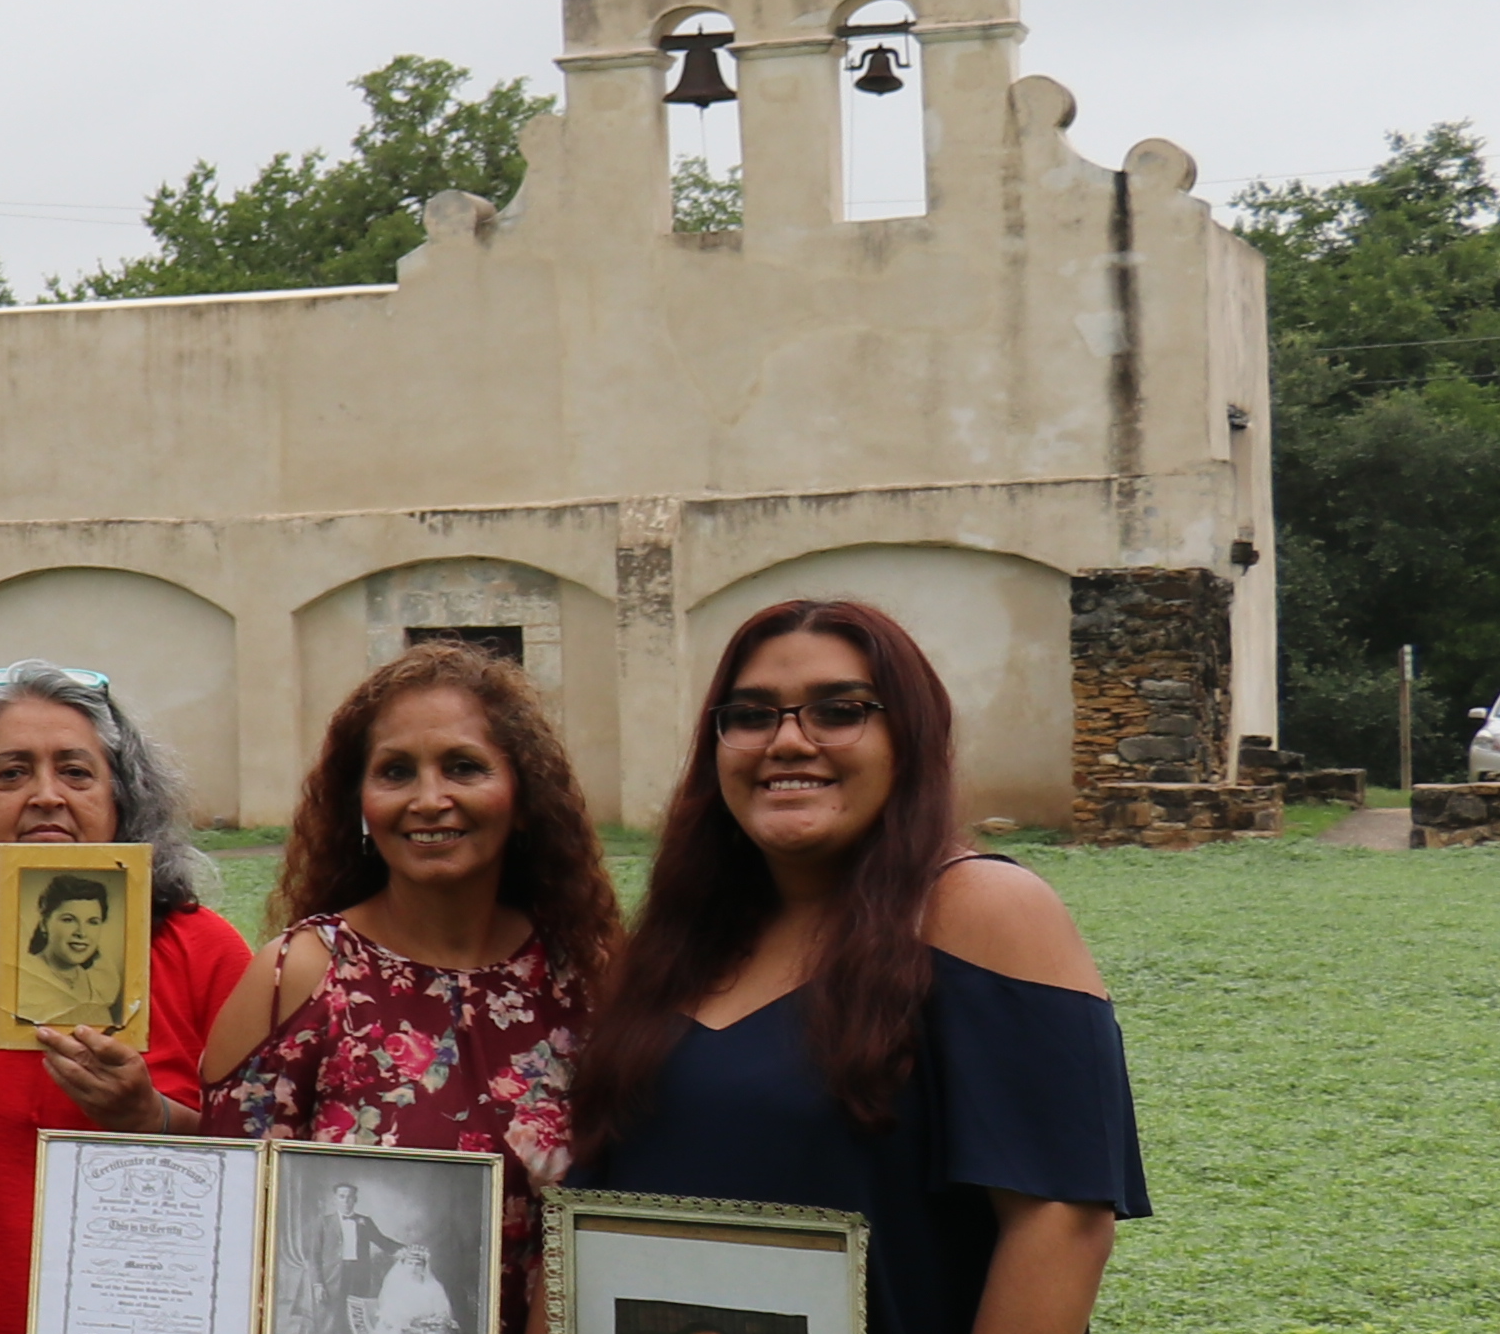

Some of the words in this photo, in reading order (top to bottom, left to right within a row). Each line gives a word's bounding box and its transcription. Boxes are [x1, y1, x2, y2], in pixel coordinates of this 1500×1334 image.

[91, 1156, 144, 1179] Certificate
[145, 1156, 157, 1166] of
[158, 1157, 206, 1184] Marriage
